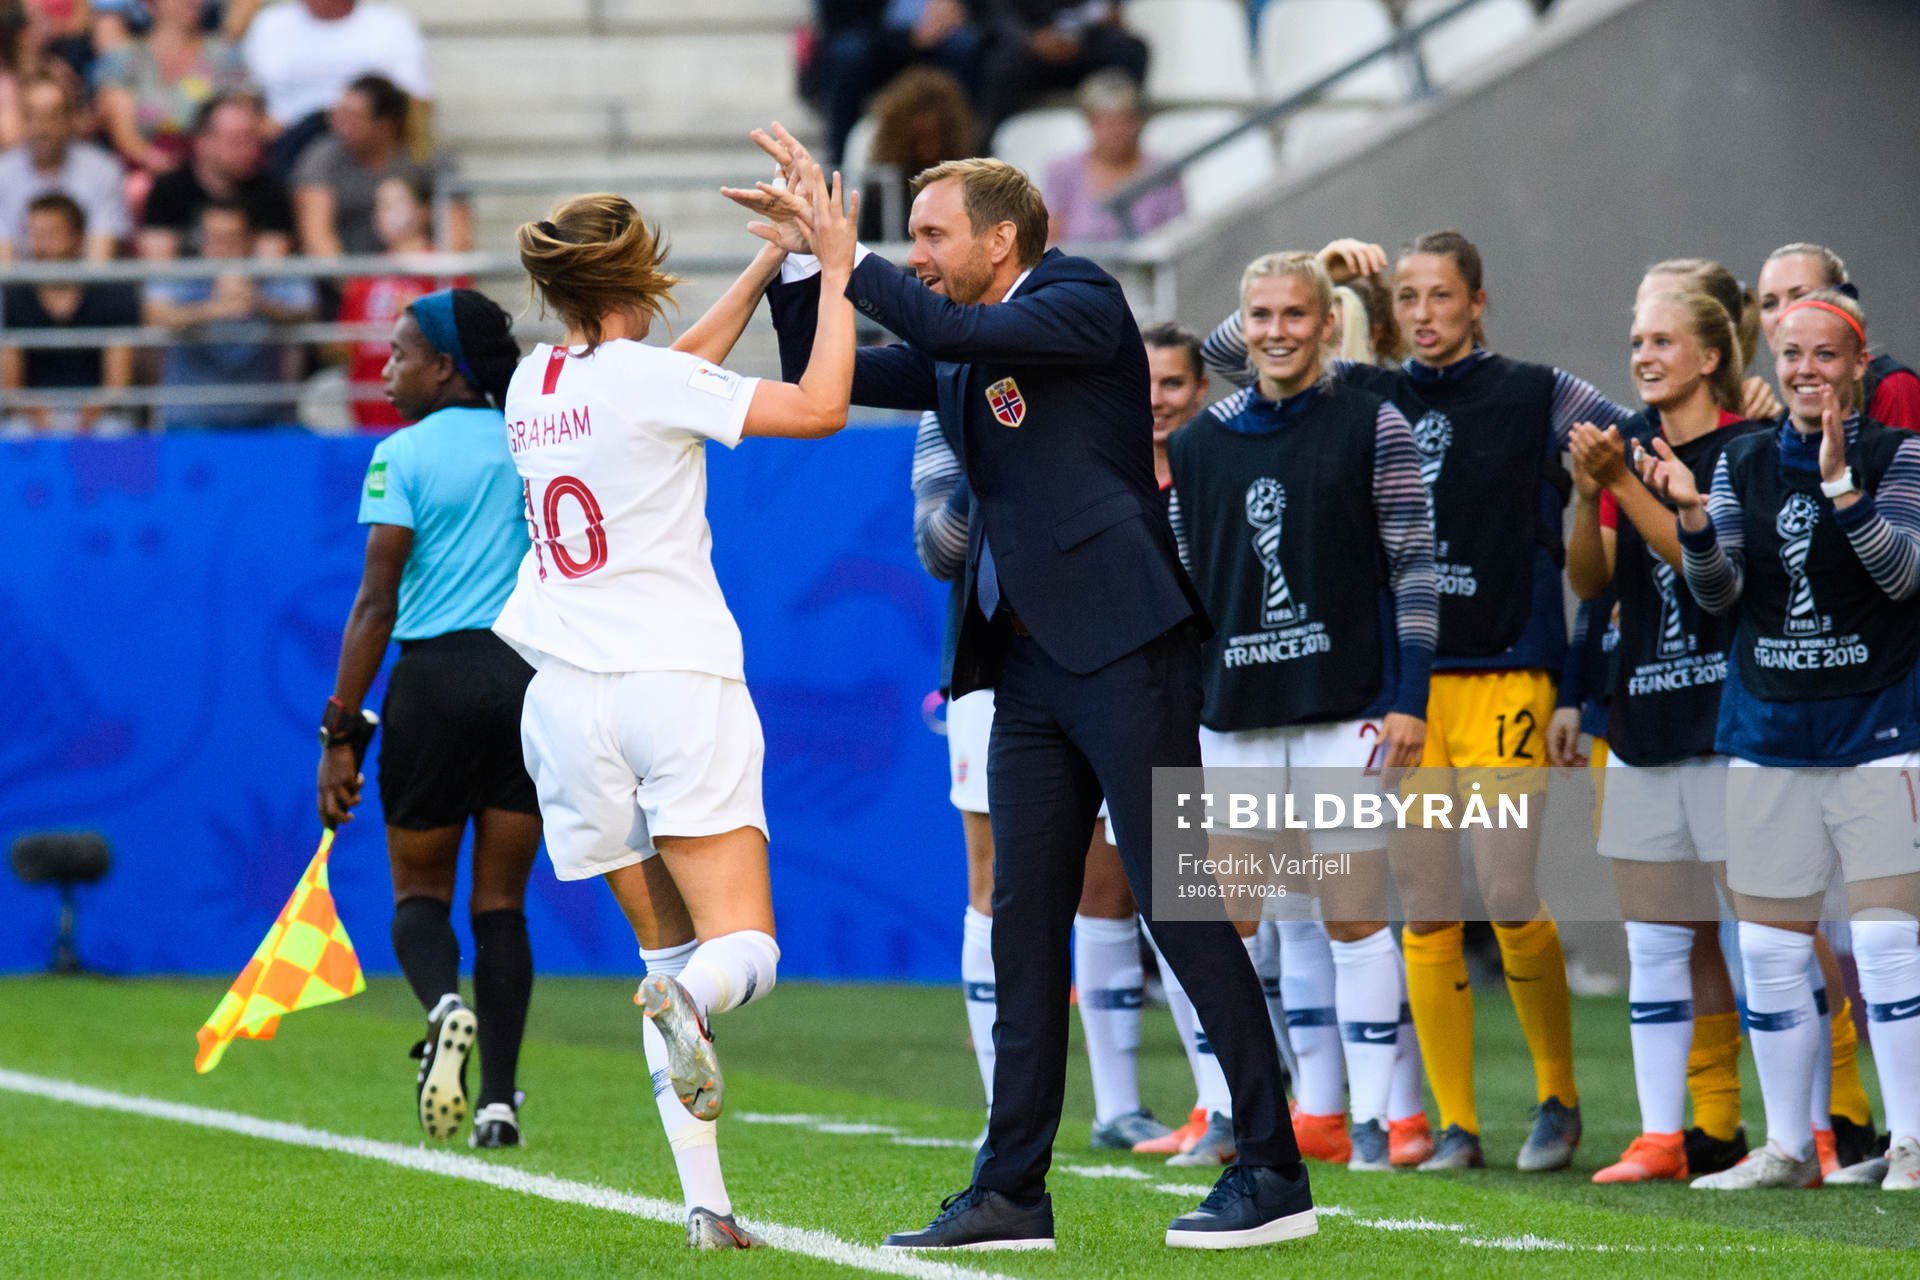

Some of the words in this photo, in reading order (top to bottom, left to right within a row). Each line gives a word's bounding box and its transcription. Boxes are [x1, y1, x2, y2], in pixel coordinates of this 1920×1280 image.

[507, 405, 591, 453] GRAHAM
[523, 472, 608, 583] 10
[1436, 573, 1477, 597] 2019
[1790, 619, 1816, 631] FIFA
[1224, 638, 1300, 668] FRANCE
[1798, 637, 1836, 649] WORLD
[1839, 633, 1860, 645] CUP
[1754, 645, 1820, 671] FRANCE
[1822, 643, 1869, 668] 2019
[1496, 709, 1536, 759] 12
